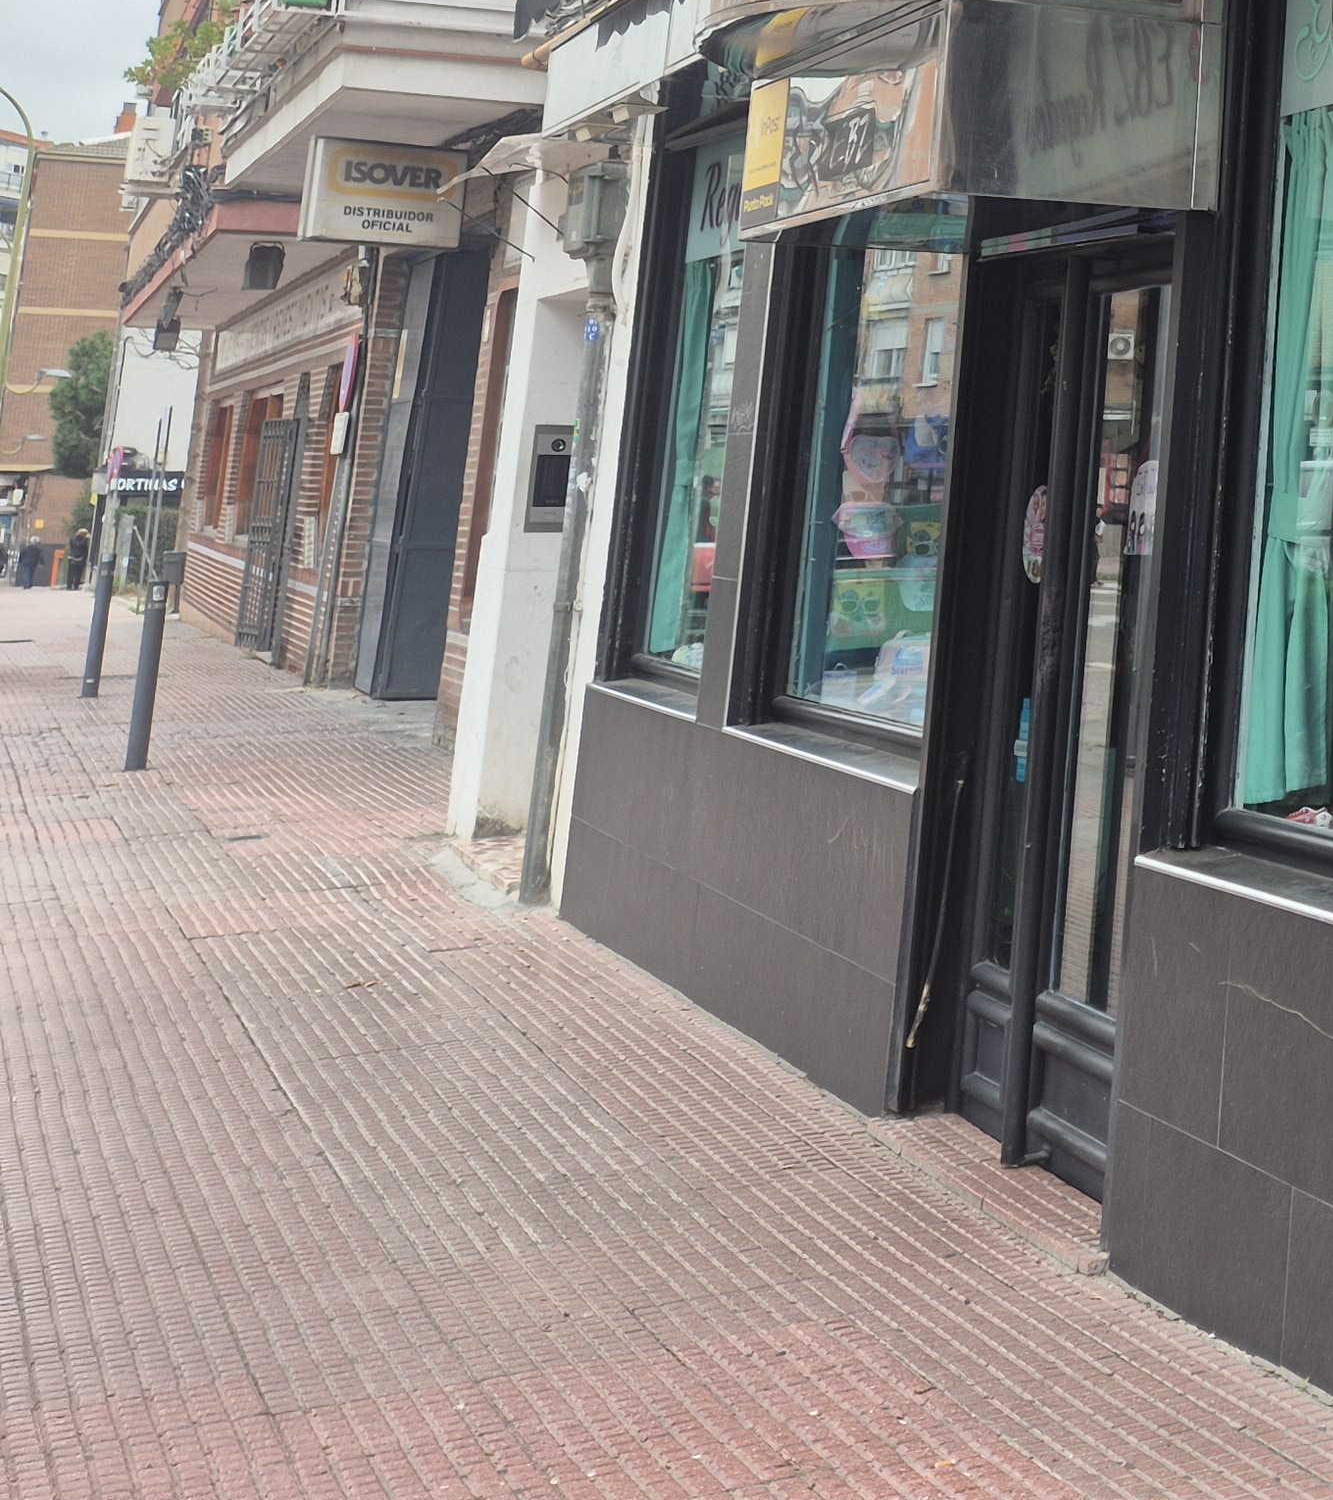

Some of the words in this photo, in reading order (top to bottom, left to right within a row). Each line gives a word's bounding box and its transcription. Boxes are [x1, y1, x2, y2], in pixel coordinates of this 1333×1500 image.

[343, 160, 442, 190] ISOVER
[343, 206, 434, 222] DISTRIBUIDOR
[361, 220, 413, 233] OFICIAL
